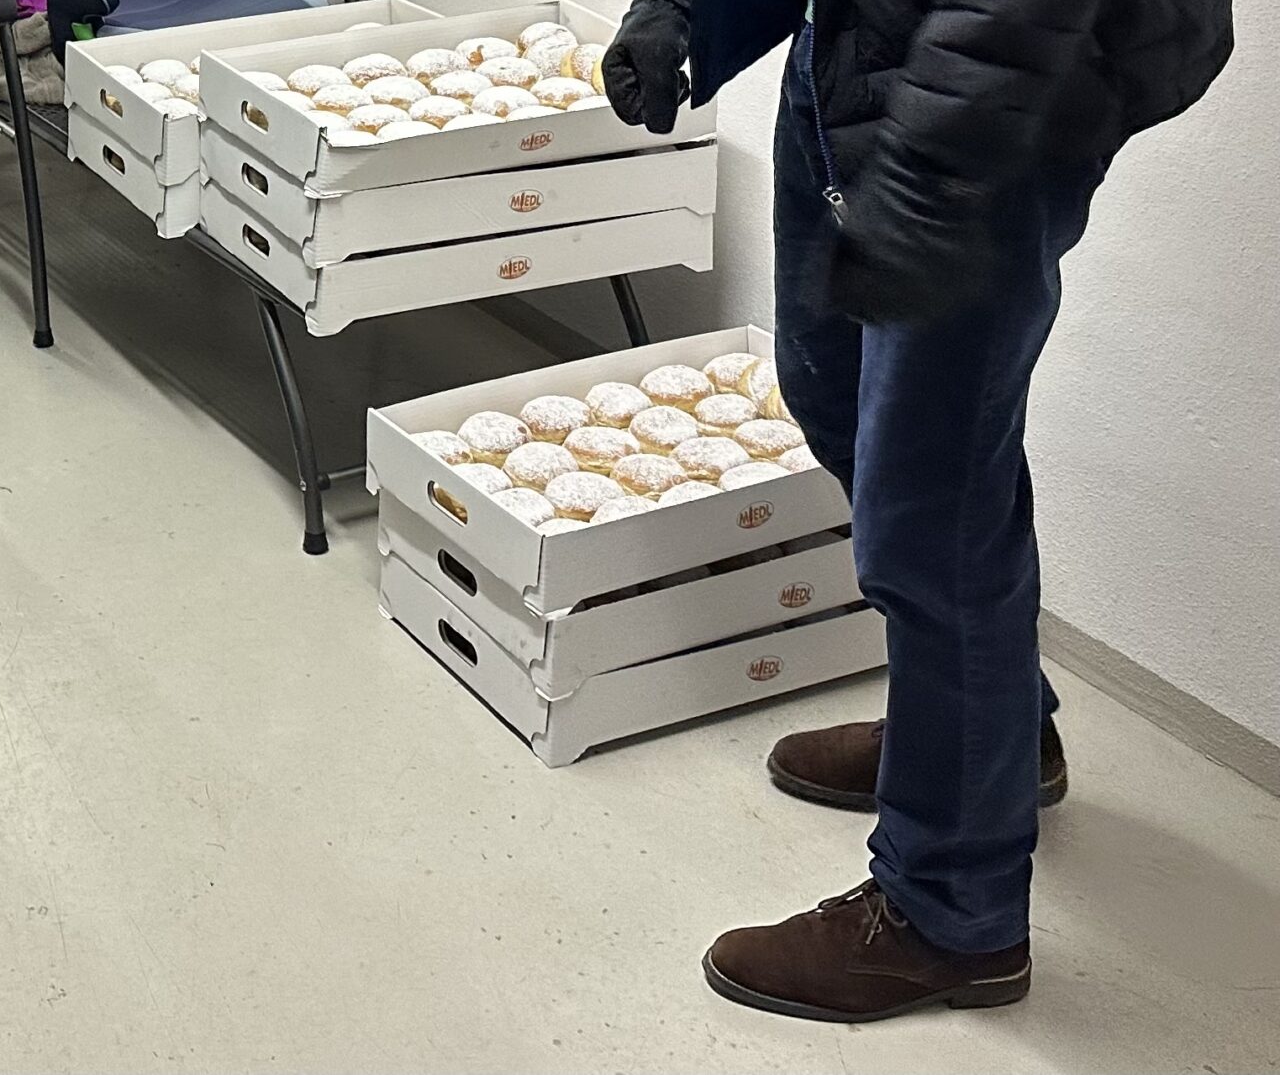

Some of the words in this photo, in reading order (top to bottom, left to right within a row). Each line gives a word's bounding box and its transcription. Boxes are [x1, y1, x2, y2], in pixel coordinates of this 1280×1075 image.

[511, 192, 541, 210] MIEDL
[500, 259, 531, 277] MIEDL
[749, 658, 781, 676] MIEDL
